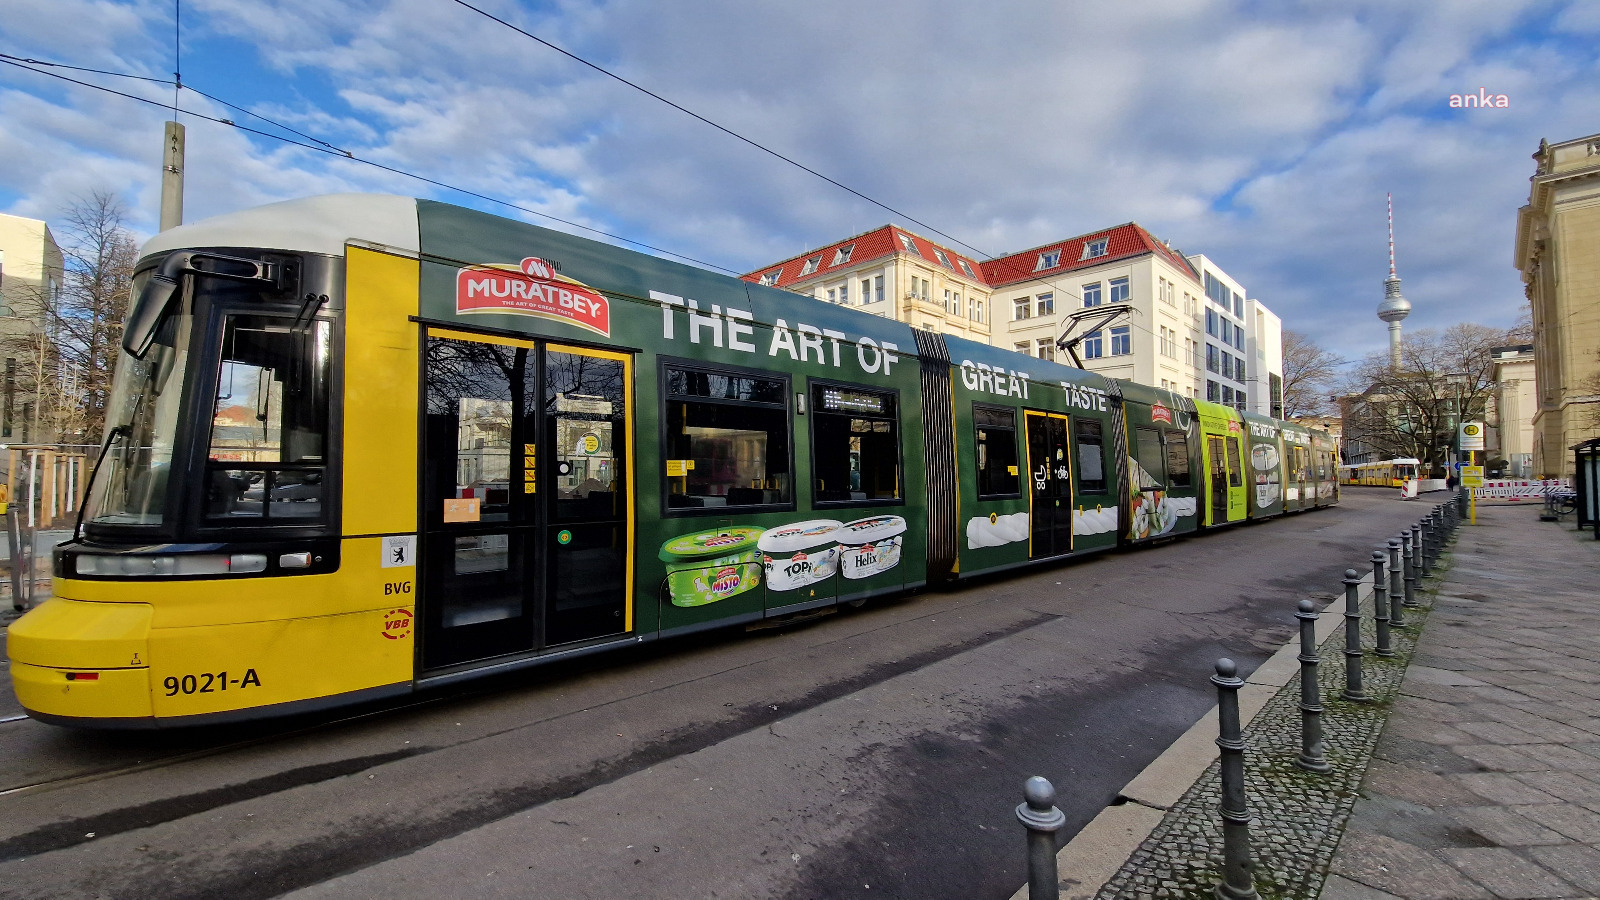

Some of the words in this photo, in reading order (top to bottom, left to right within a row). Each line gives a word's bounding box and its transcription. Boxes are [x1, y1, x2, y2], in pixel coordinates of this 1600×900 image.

[467, 278, 601, 318] MURATBEY
[538, 304, 556, 312] GREAT
[557, 308, 574, 317] TASTE
[649, 290, 755, 353] THE
[769, 318, 845, 367] ART
[855, 336, 899, 375] OF
[960, 360, 1029, 399] GREAT
[1060, 381, 1107, 412] TASTE
[855, 552, 877, 568] Helix
[384, 581, 411, 596] BVG
[385, 618, 410, 630] VBB
[164, 669, 261, 697] 9021-A
